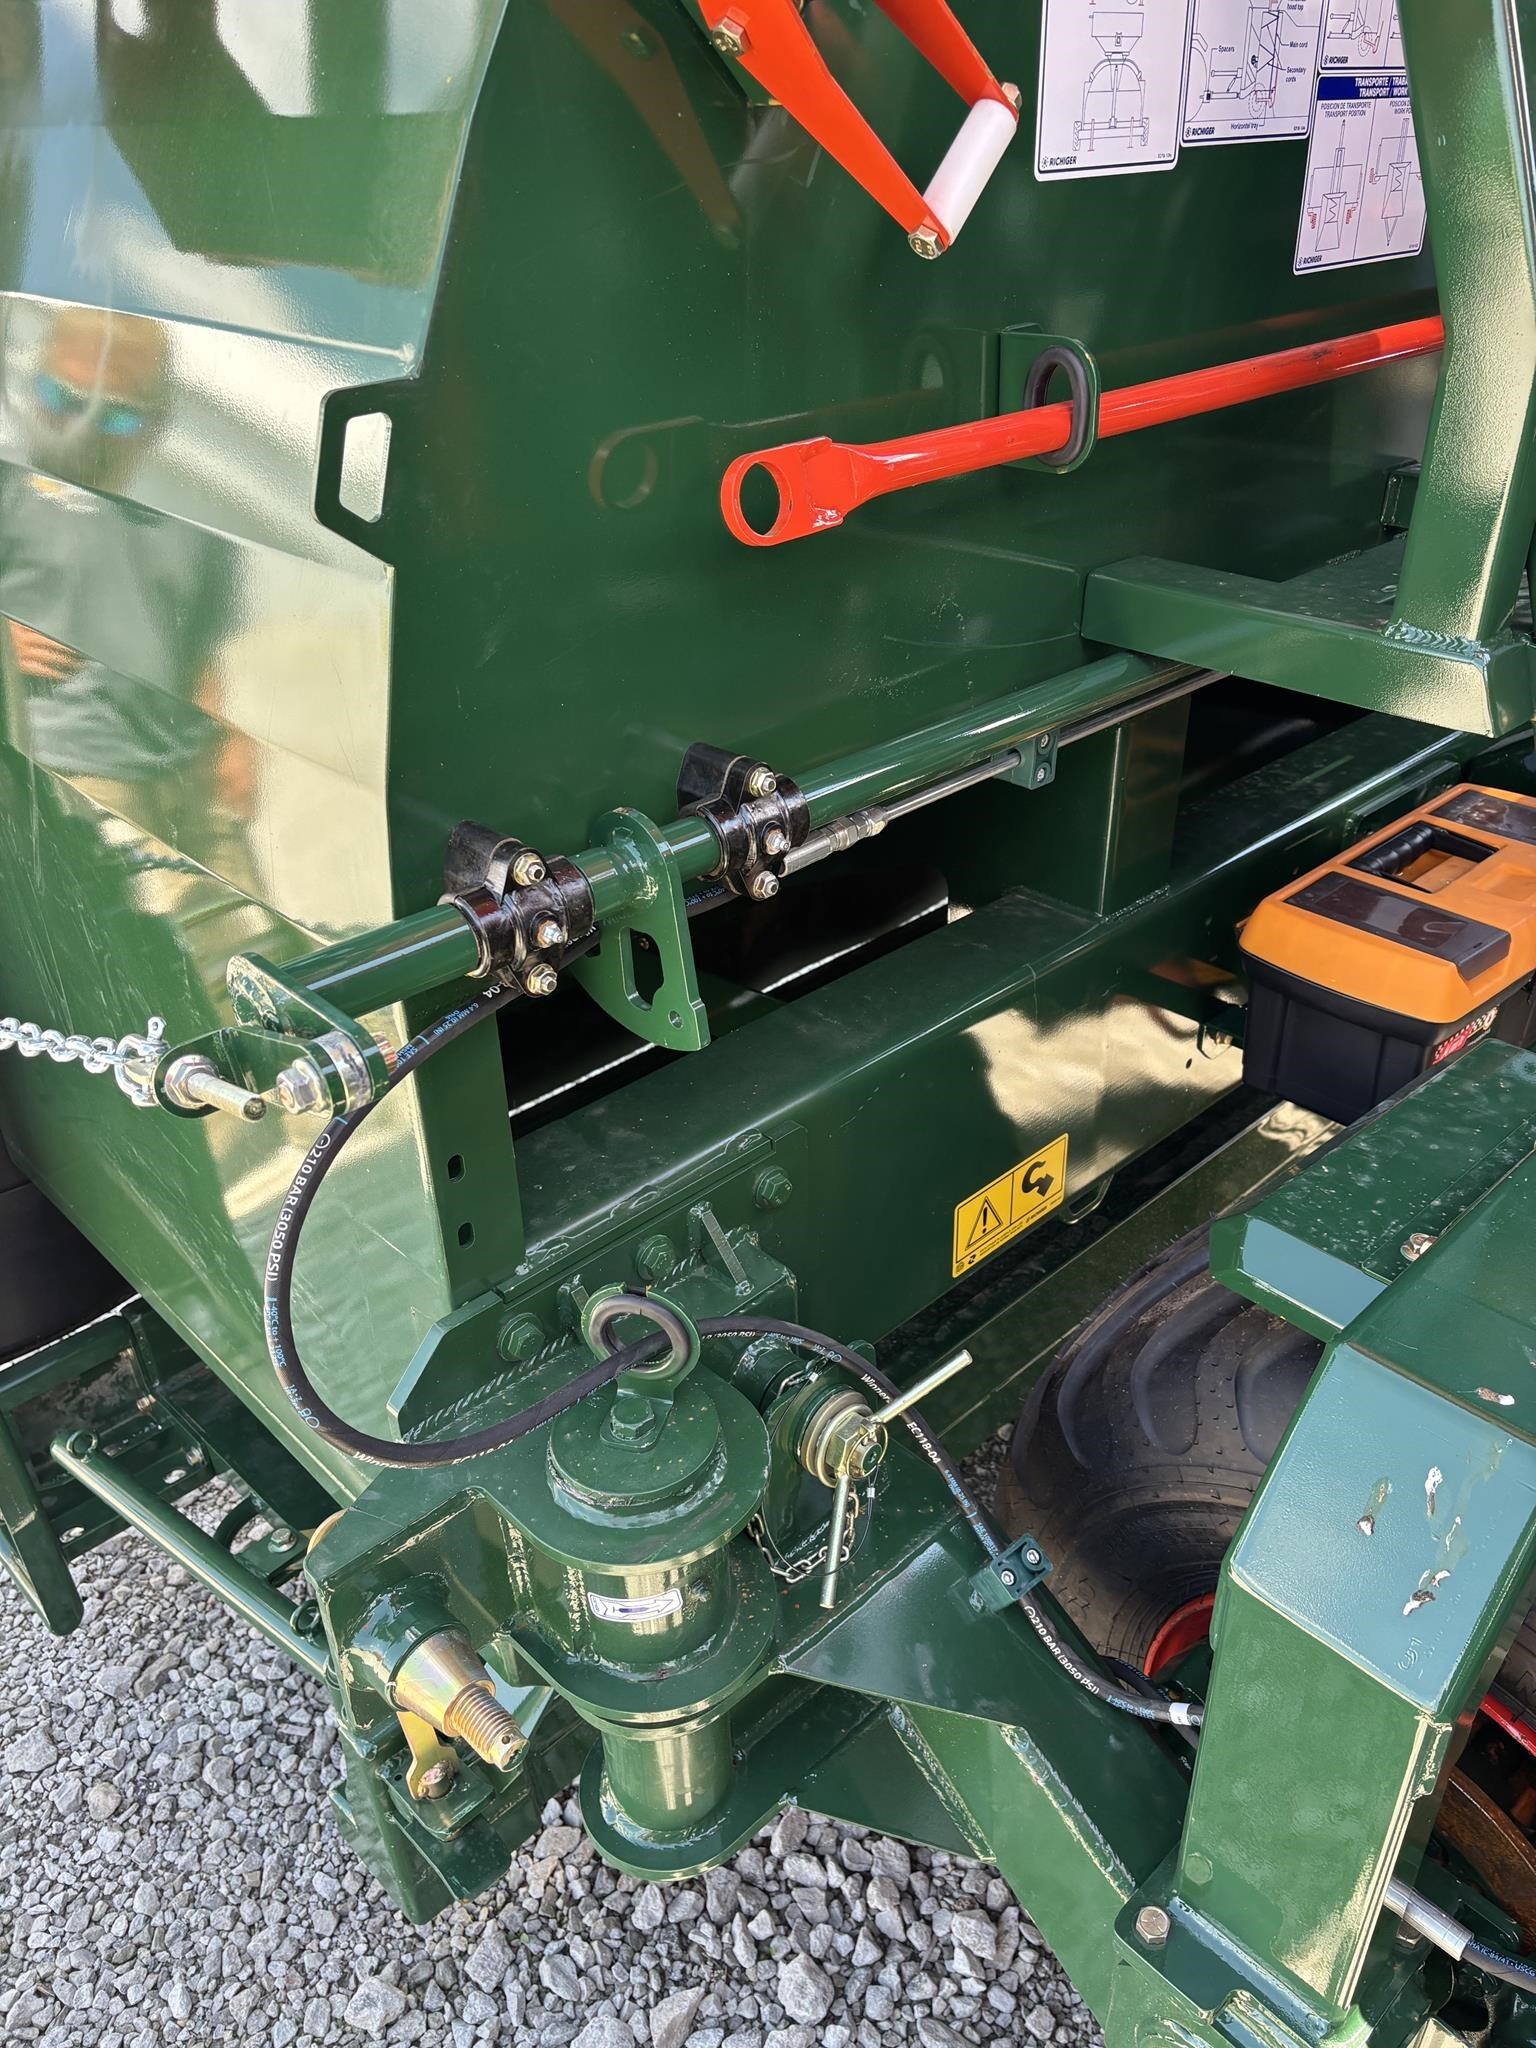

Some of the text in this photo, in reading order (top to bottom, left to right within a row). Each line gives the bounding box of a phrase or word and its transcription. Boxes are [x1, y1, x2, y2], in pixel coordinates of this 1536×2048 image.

[1218, 45, 1235, 53] Spacers
[1329, 56, 1349, 64] RICHIGER
[1286, 66, 1306, 74] Secondary
[1355, 77, 1389, 87] TRANSPORTE
[1360, 87, 1389, 98] TRANSPORT
[1346, 101, 1372, 109] TRANSPORTE
[1325, 109, 1366, 118] TRANSPORT POSITION
[1192, 126, 1215, 136] RICHIGER
[1231, 122, 1259, 131] Horizontal tray
[1049, 156, 1077, 166] RICHIGER
[1303, 255, 1322, 265] RICHIGER
[469, 1002, 479, 1012] 6.4
[458, 1008, 471, 1020] MM
[286, 1175, 307, 1206] BAR
[271, 1207, 294, 1250] (3050
[265, 1252, 281, 1282] PSI)
[271, 1326, 278, 1336] to
[274, 1345, 287, 1368] 100°C
[907, 1421, 941, 1464] EC118-04
[1043, 1635, 1061, 1656] BAR
[1057, 1654, 1082, 1680] (3050
[1080, 1677, 1100, 1694] PSI)
[1514, 1963, 1536, 1977] USCG
